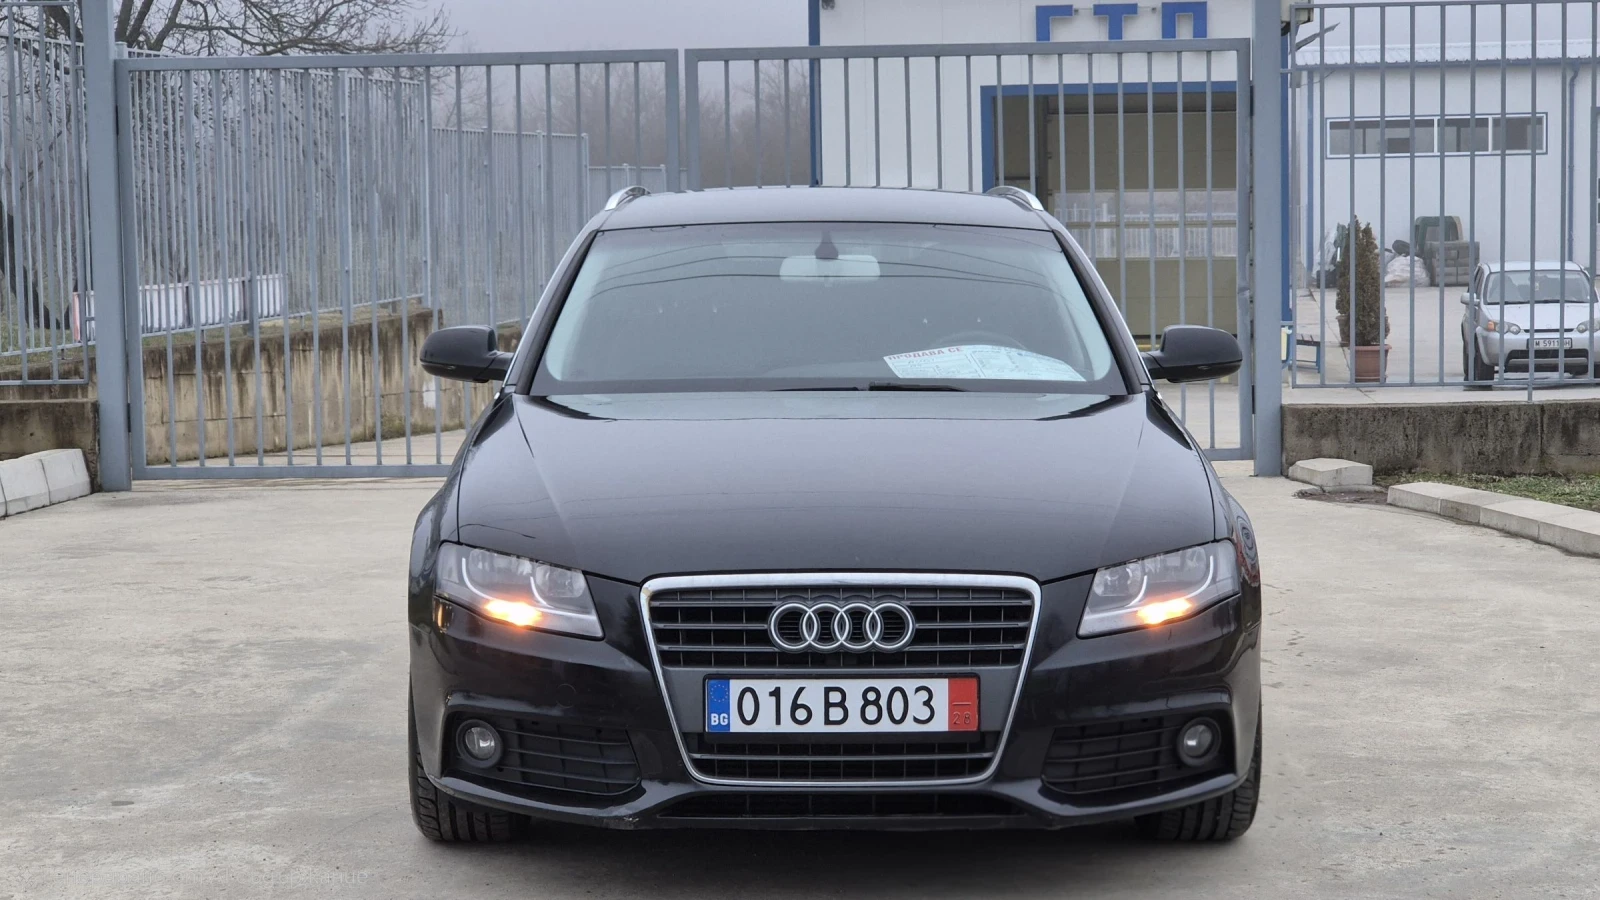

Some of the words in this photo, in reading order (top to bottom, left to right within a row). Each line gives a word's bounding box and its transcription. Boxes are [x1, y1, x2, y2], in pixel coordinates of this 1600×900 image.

[1036, 2, 1207, 41] ГТП
[887, 349, 945, 360] ПРОДАВА
[710, 713, 729, 726] BG
[952, 711, 972, 725] 28
